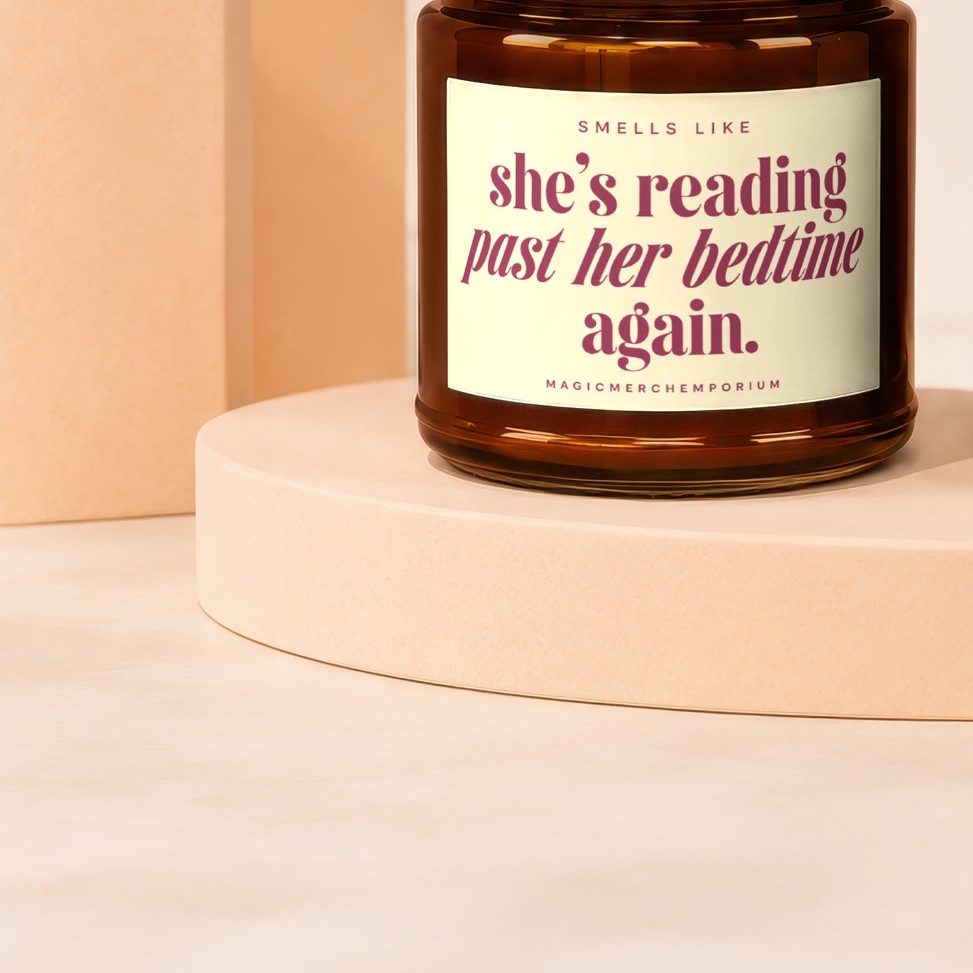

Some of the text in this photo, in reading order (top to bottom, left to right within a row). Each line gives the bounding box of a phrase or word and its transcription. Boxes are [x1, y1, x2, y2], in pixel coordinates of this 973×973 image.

[578, 120, 752, 135] SMELLS LIKE
[490, 152, 847, 223] she’s reading
[461, 222, 864, 288] past her bedtime
[582, 299, 758, 371] again.
[546, 379, 781, 393] MAGICMERCHEMPORIUM
